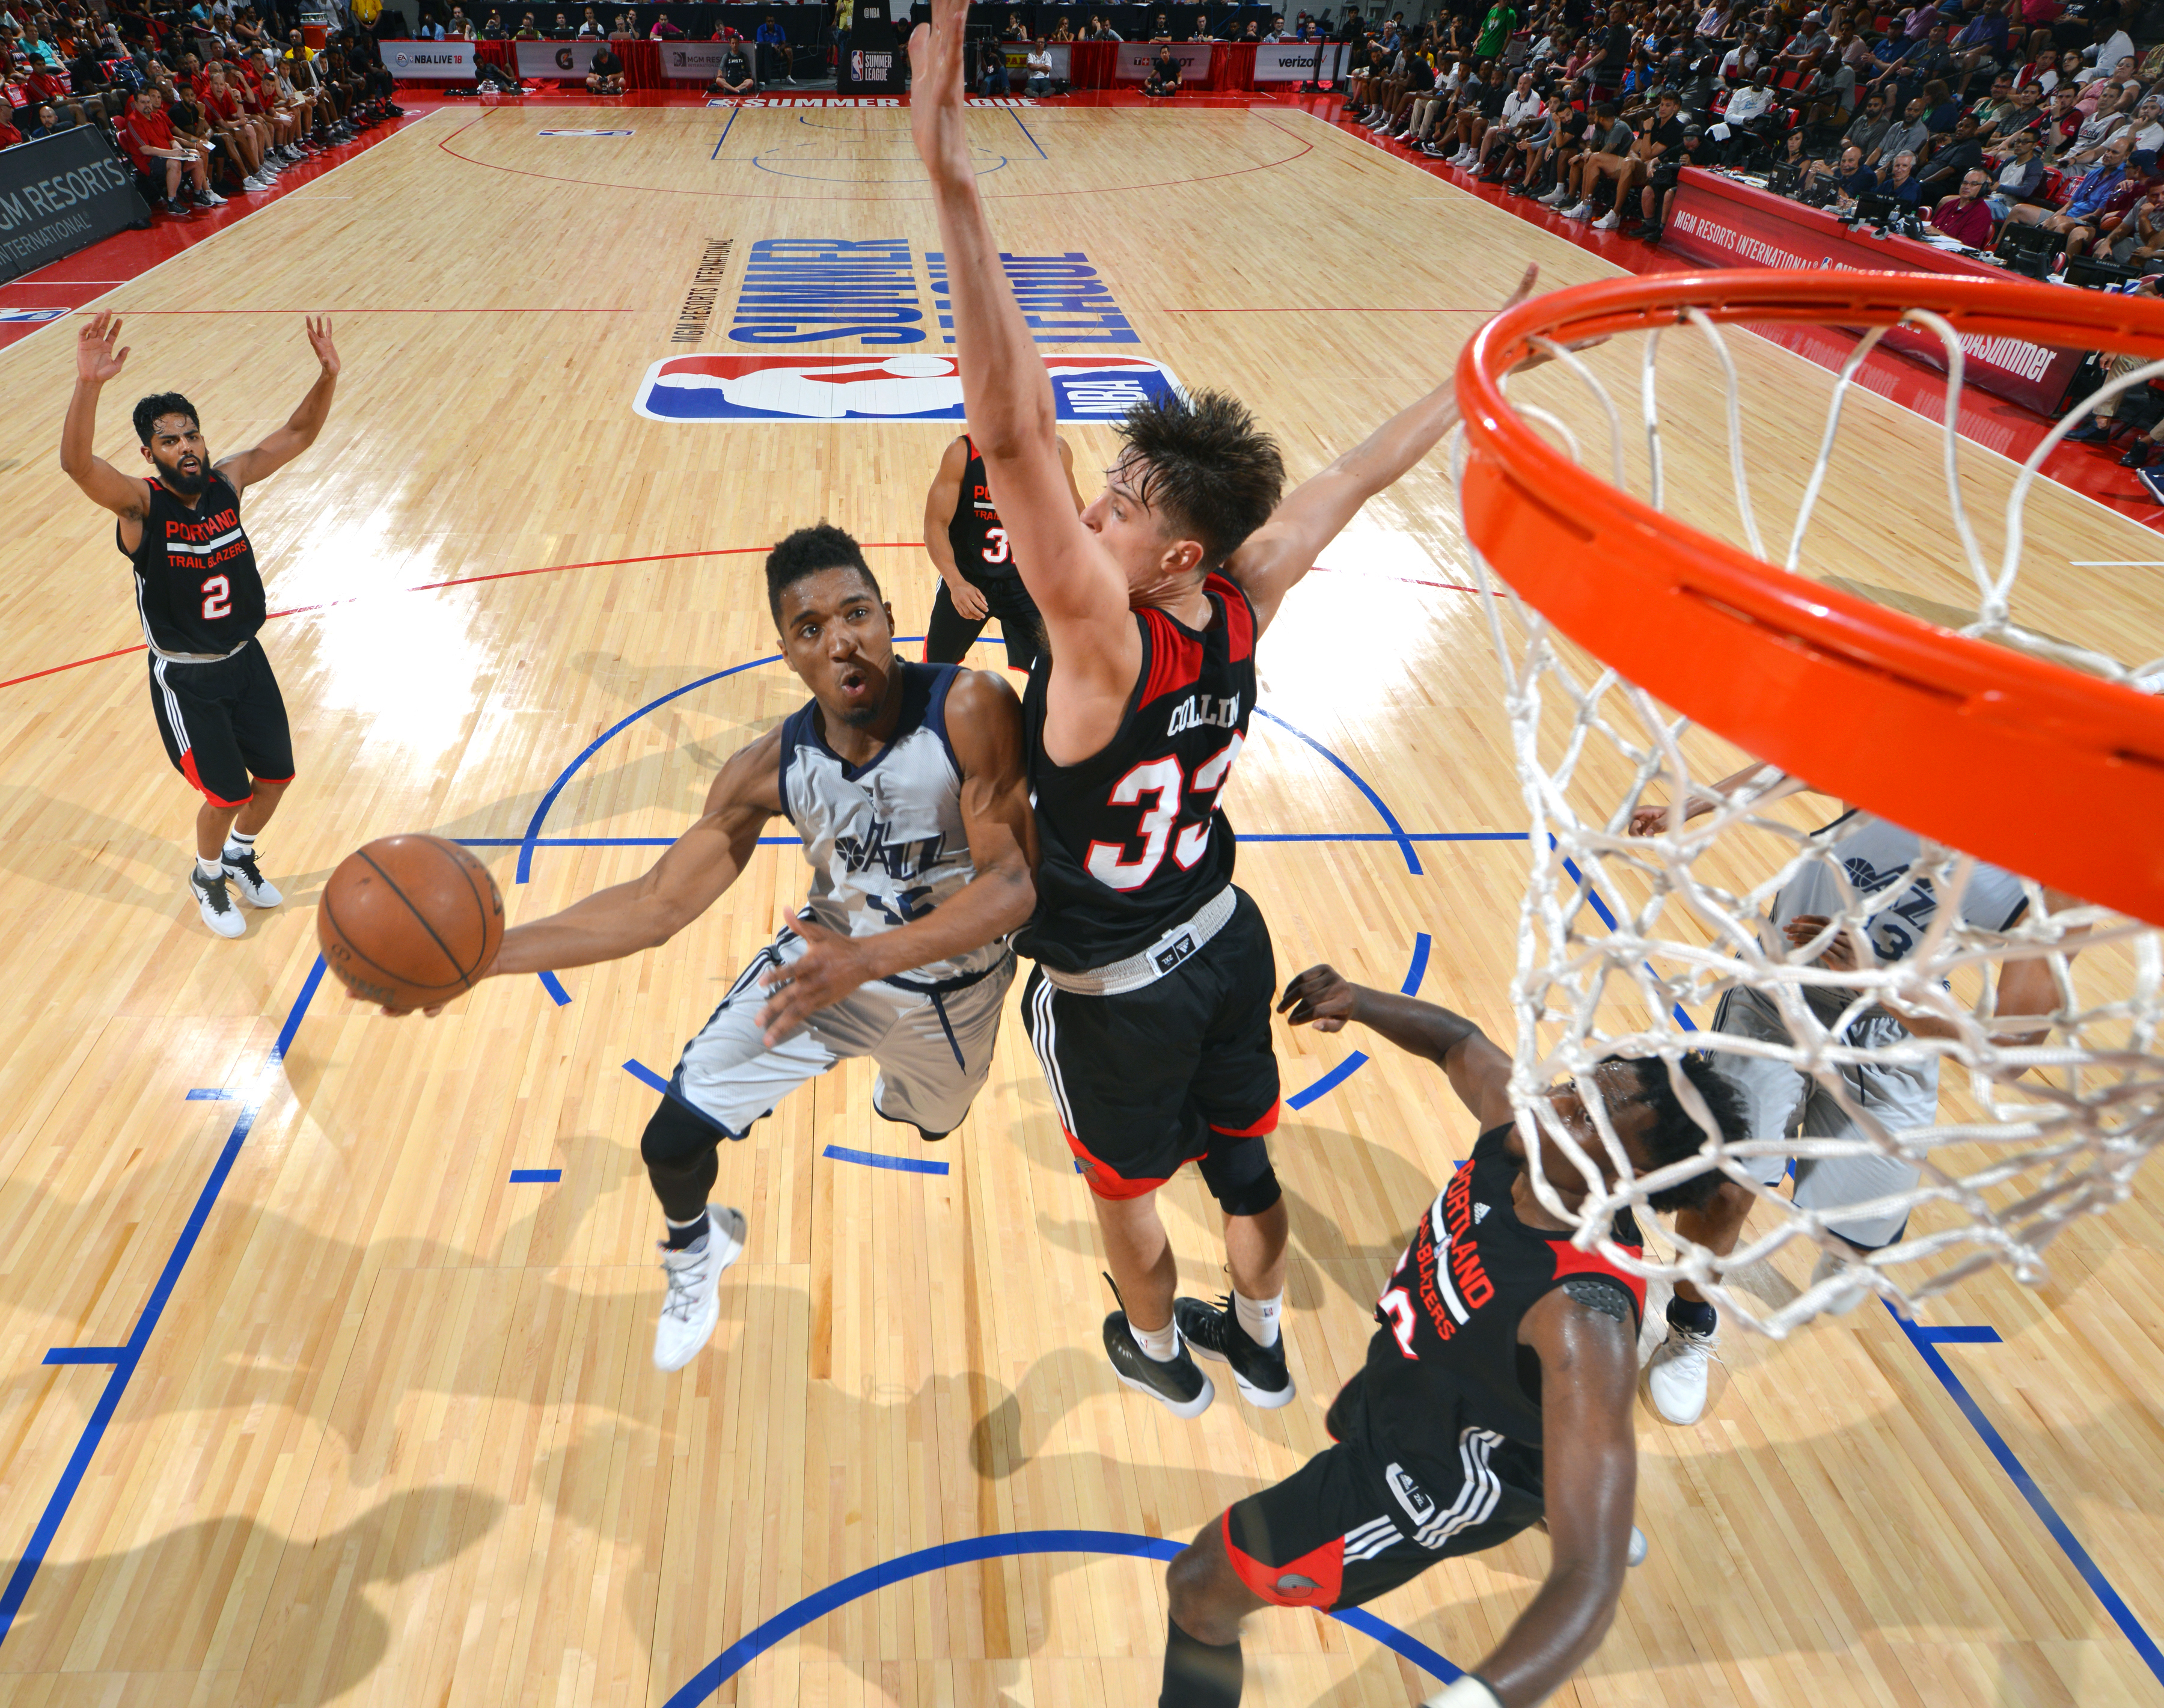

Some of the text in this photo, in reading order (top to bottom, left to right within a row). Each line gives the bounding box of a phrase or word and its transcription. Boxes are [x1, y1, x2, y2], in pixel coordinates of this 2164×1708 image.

[864, 7, 880, 19] @NBA
[415, 55, 462, 64] NBA LIVE 18
[865, 54, 892, 68] SUMMER
[865, 68, 888, 81] LEAGUE
[742, 99, 900, 108] SUMMER
[22, 158, 126, 216] RESORTS
[1673, 210, 1698, 233] MGM
[1696, 219, 1737, 249] RESORTS
[2095, 260, 2120, 268] SAMSUNG
[670, 239, 734, 343] MGM RESORTS INTERNATIONAL
[728, 239, 927, 344] SUMMER
[168, 540, 247, 569] TRAIL BLAZERS
[201, 574, 232, 620] 2
[1161, 954, 1173, 964] 2XL
[1446, 1159, 1495, 1309] PORTLAND
[1416, 1242, 1456, 1341] BLAZERS
